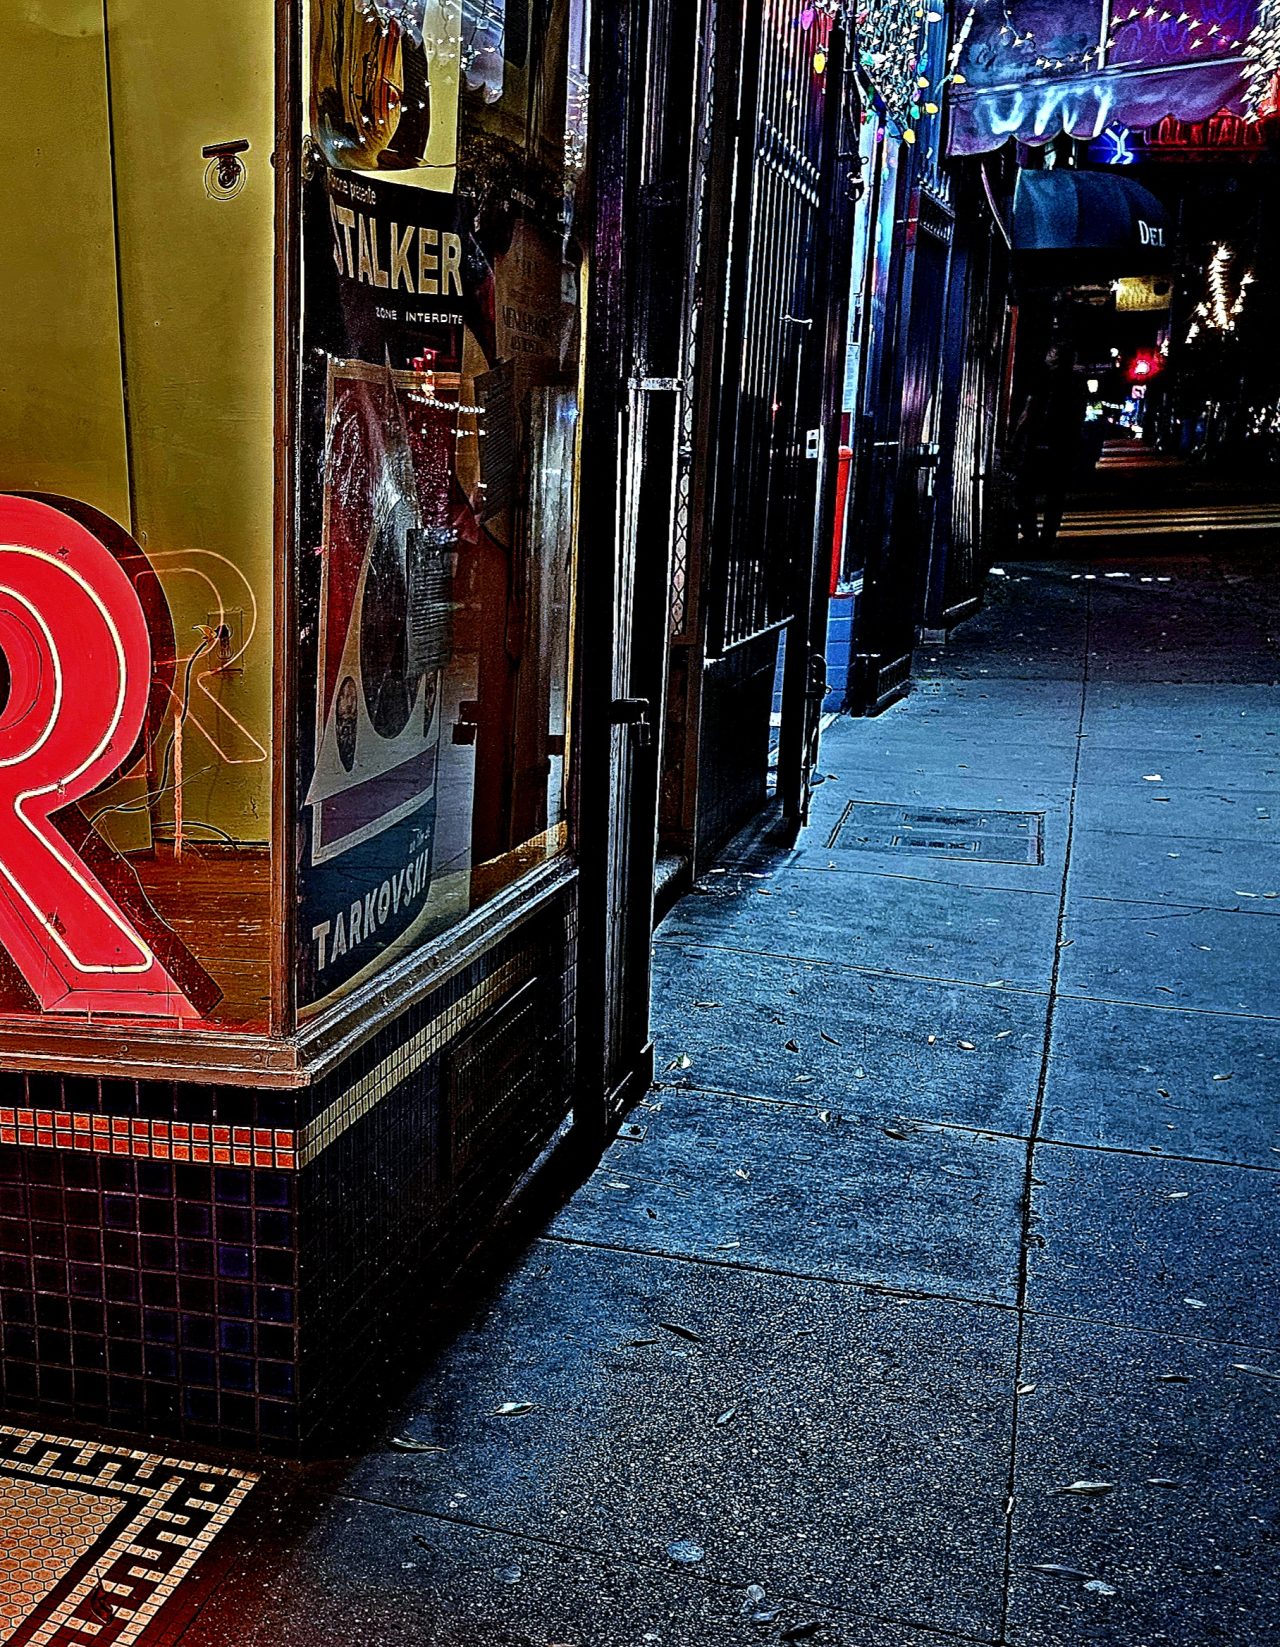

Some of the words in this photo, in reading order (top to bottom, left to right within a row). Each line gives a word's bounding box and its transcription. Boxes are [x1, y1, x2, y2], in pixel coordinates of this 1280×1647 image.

[375, 306, 398, 321] ZONE
[405, 310, 464, 325] INTERDITE
[311, 848, 430, 972] TARKOVSKI
